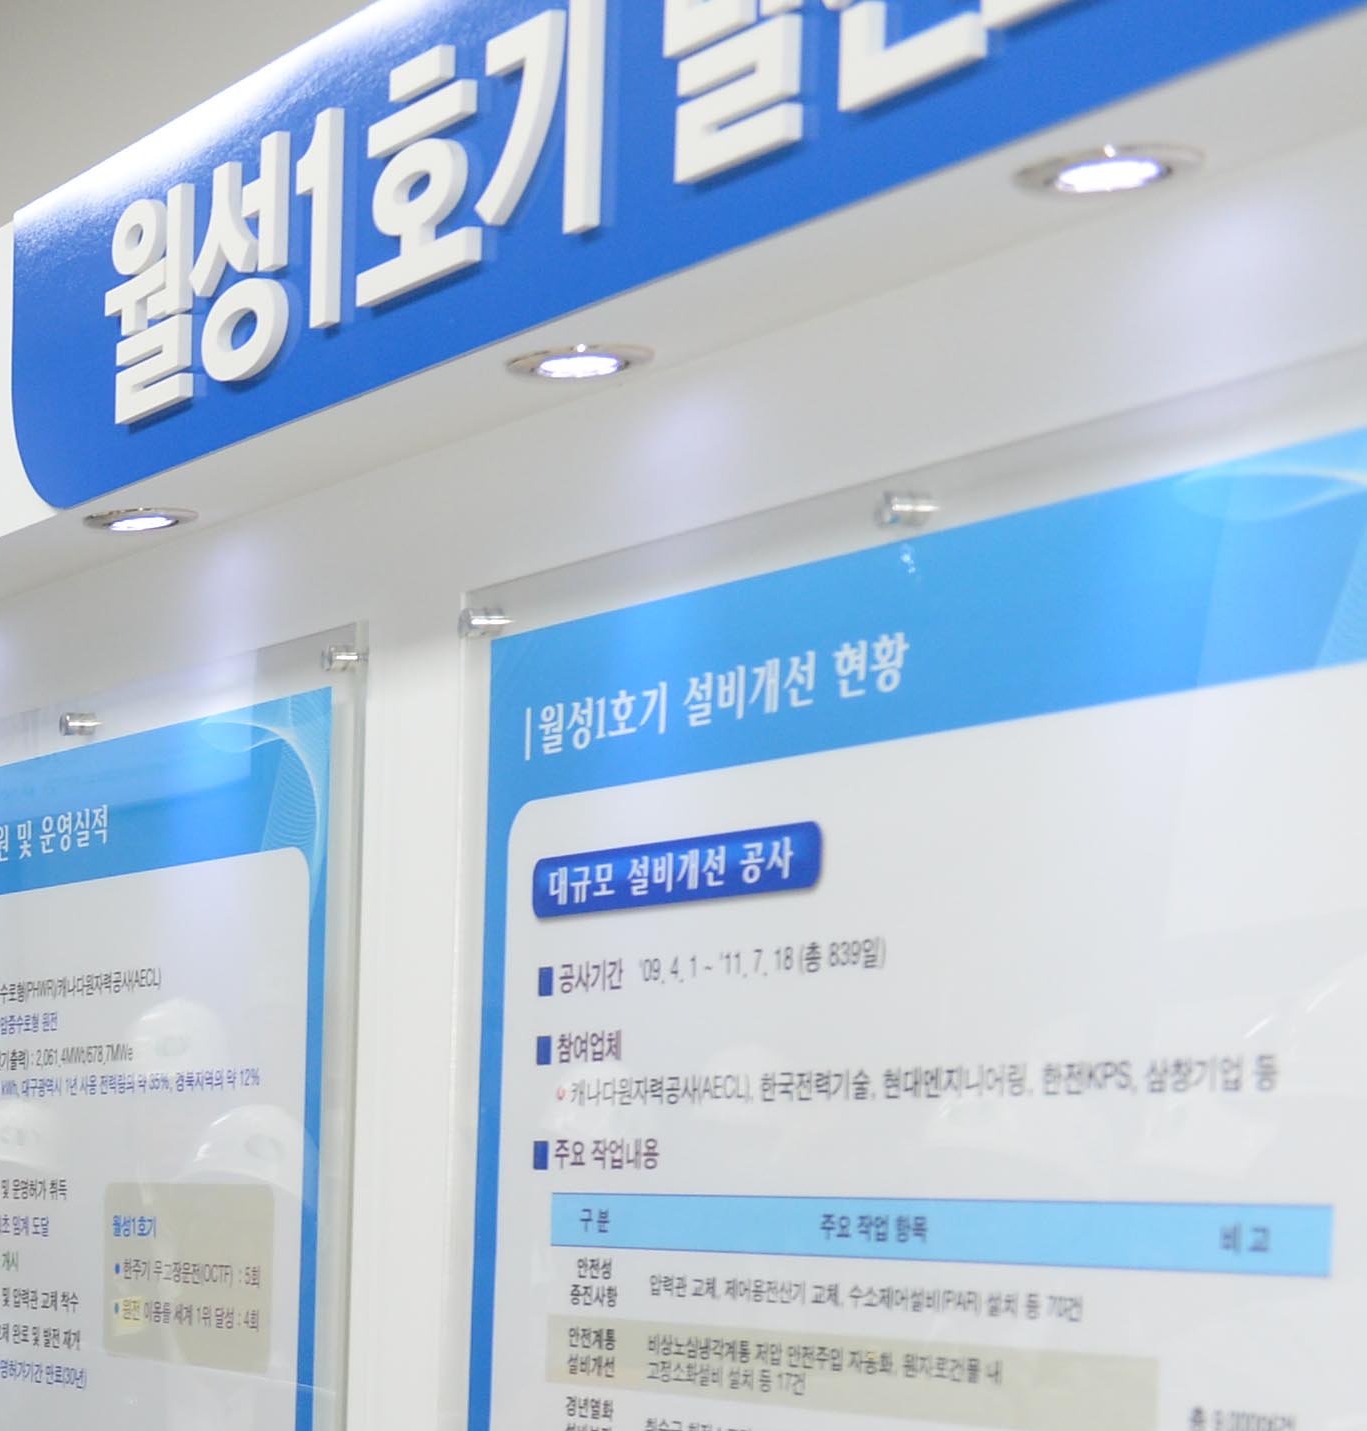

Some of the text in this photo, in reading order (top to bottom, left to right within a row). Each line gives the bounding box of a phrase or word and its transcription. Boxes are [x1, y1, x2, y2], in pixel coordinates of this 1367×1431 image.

[103, 0, 605, 426] 월성1호기
[538, 632, 910, 757] 월성1호기 설비개선 현황
[17, 820, 33, 860] 및
[39, 803, 109, 855] 운영실적
[547, 836, 794, 906] 대규모 설비개선 공사
[558, 957, 624, 995] 공사기간
[557, 1029, 623, 1064] 참여업체
[553, 1137, 661, 1171] 주요 작업내용
[578, 1207, 611, 1233] 구분
[821, 1213, 852, 1241] 주요
[857, 1213, 890, 1243] 작업
[895, 1214, 928, 1245] 항목
[576, 1256, 613, 1281] 안전성
[649, 1273, 687, 1299] 압력관
[569, 1283, 618, 1308] 증진사항
[567, 1326, 616, 1351] 안전계통
[567, 1353, 615, 1379] 설비개선
